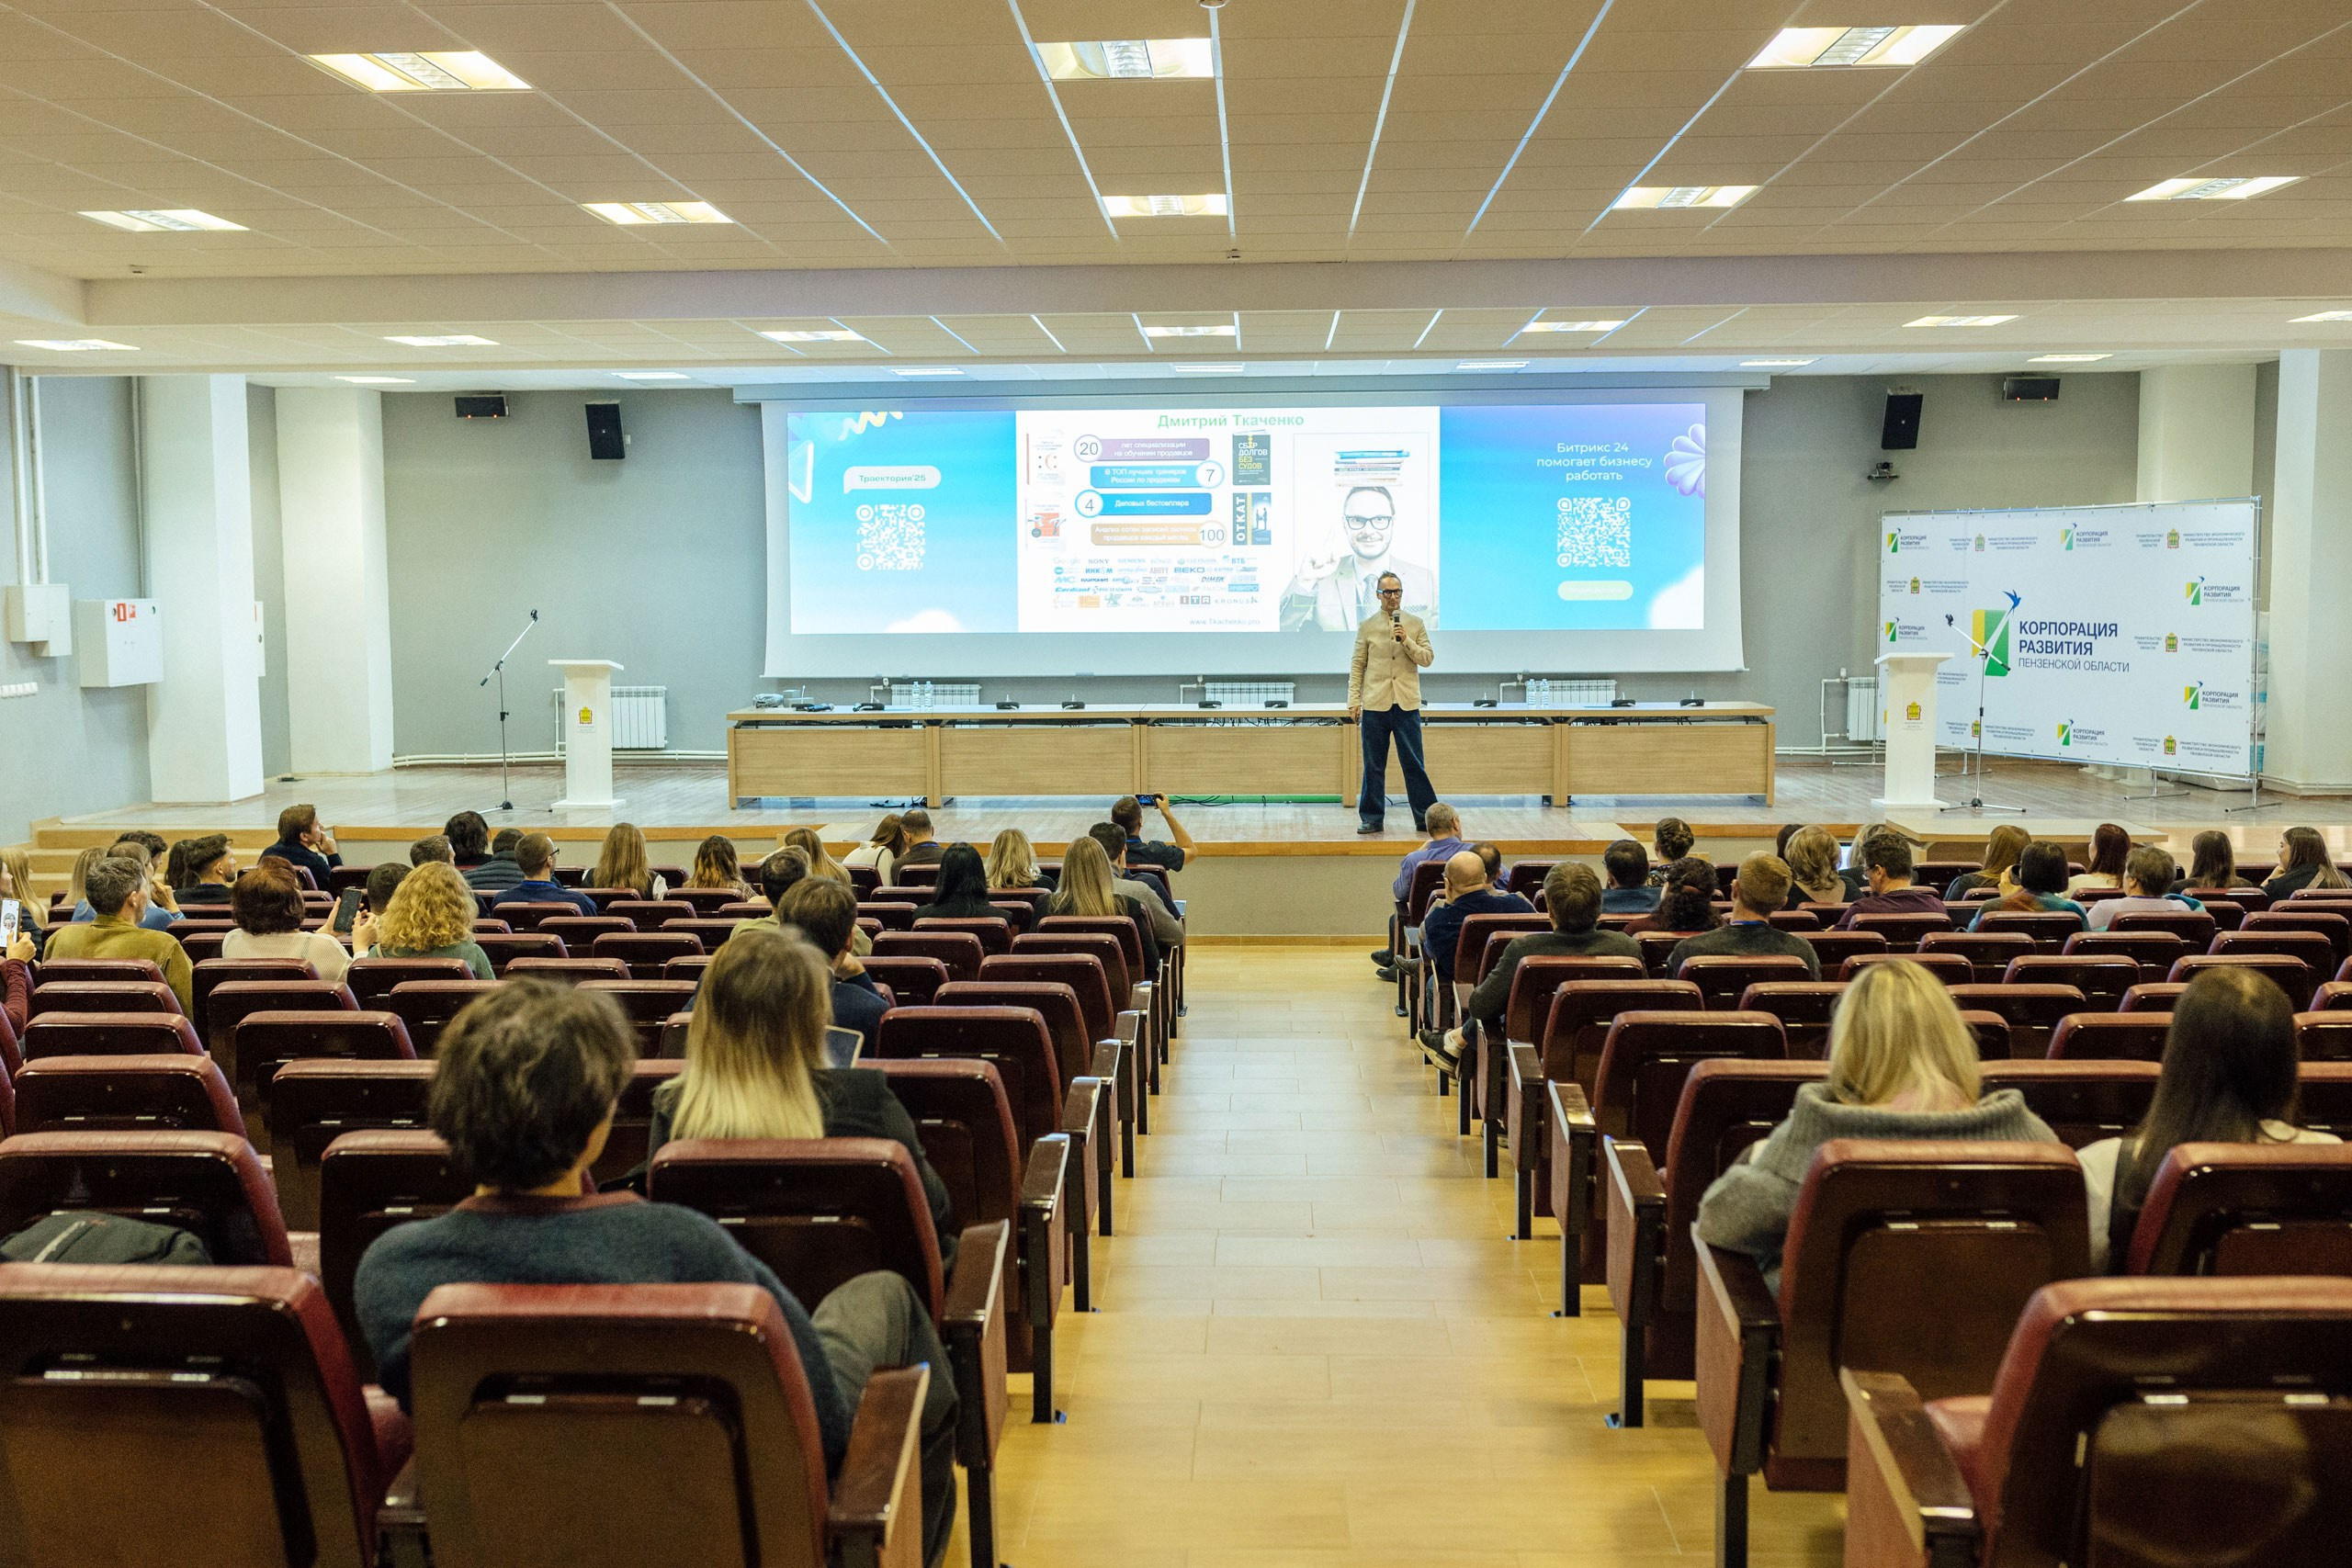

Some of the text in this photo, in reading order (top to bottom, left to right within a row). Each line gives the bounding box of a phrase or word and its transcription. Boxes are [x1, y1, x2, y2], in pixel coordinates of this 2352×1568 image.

[1158, 414, 1305, 429] Дмитрий Ткаченко
[1080, 442, 1099, 456] 20
[1238, 448, 1268, 457] ДОЛГОВ
[1557, 442, 1629, 455] Битрикс 24
[1536, 456, 1653, 468] помогает бизнесу
[1206, 468, 1216, 482] 7
[1566, 469, 1623, 482] работать
[1084, 499, 1094, 512] 4
[1236, 496, 1246, 542] ОТКАТ
[1199, 529, 1225, 541] 100
[2019, 621, 2119, 639] КОРПОРАЦИЯ
[2018, 639, 2094, 656] РАЗВИТИЯ
[2018, 658, 2130, 672] ПЕНЗЕНСКОЙ ОБЛАСТИ
